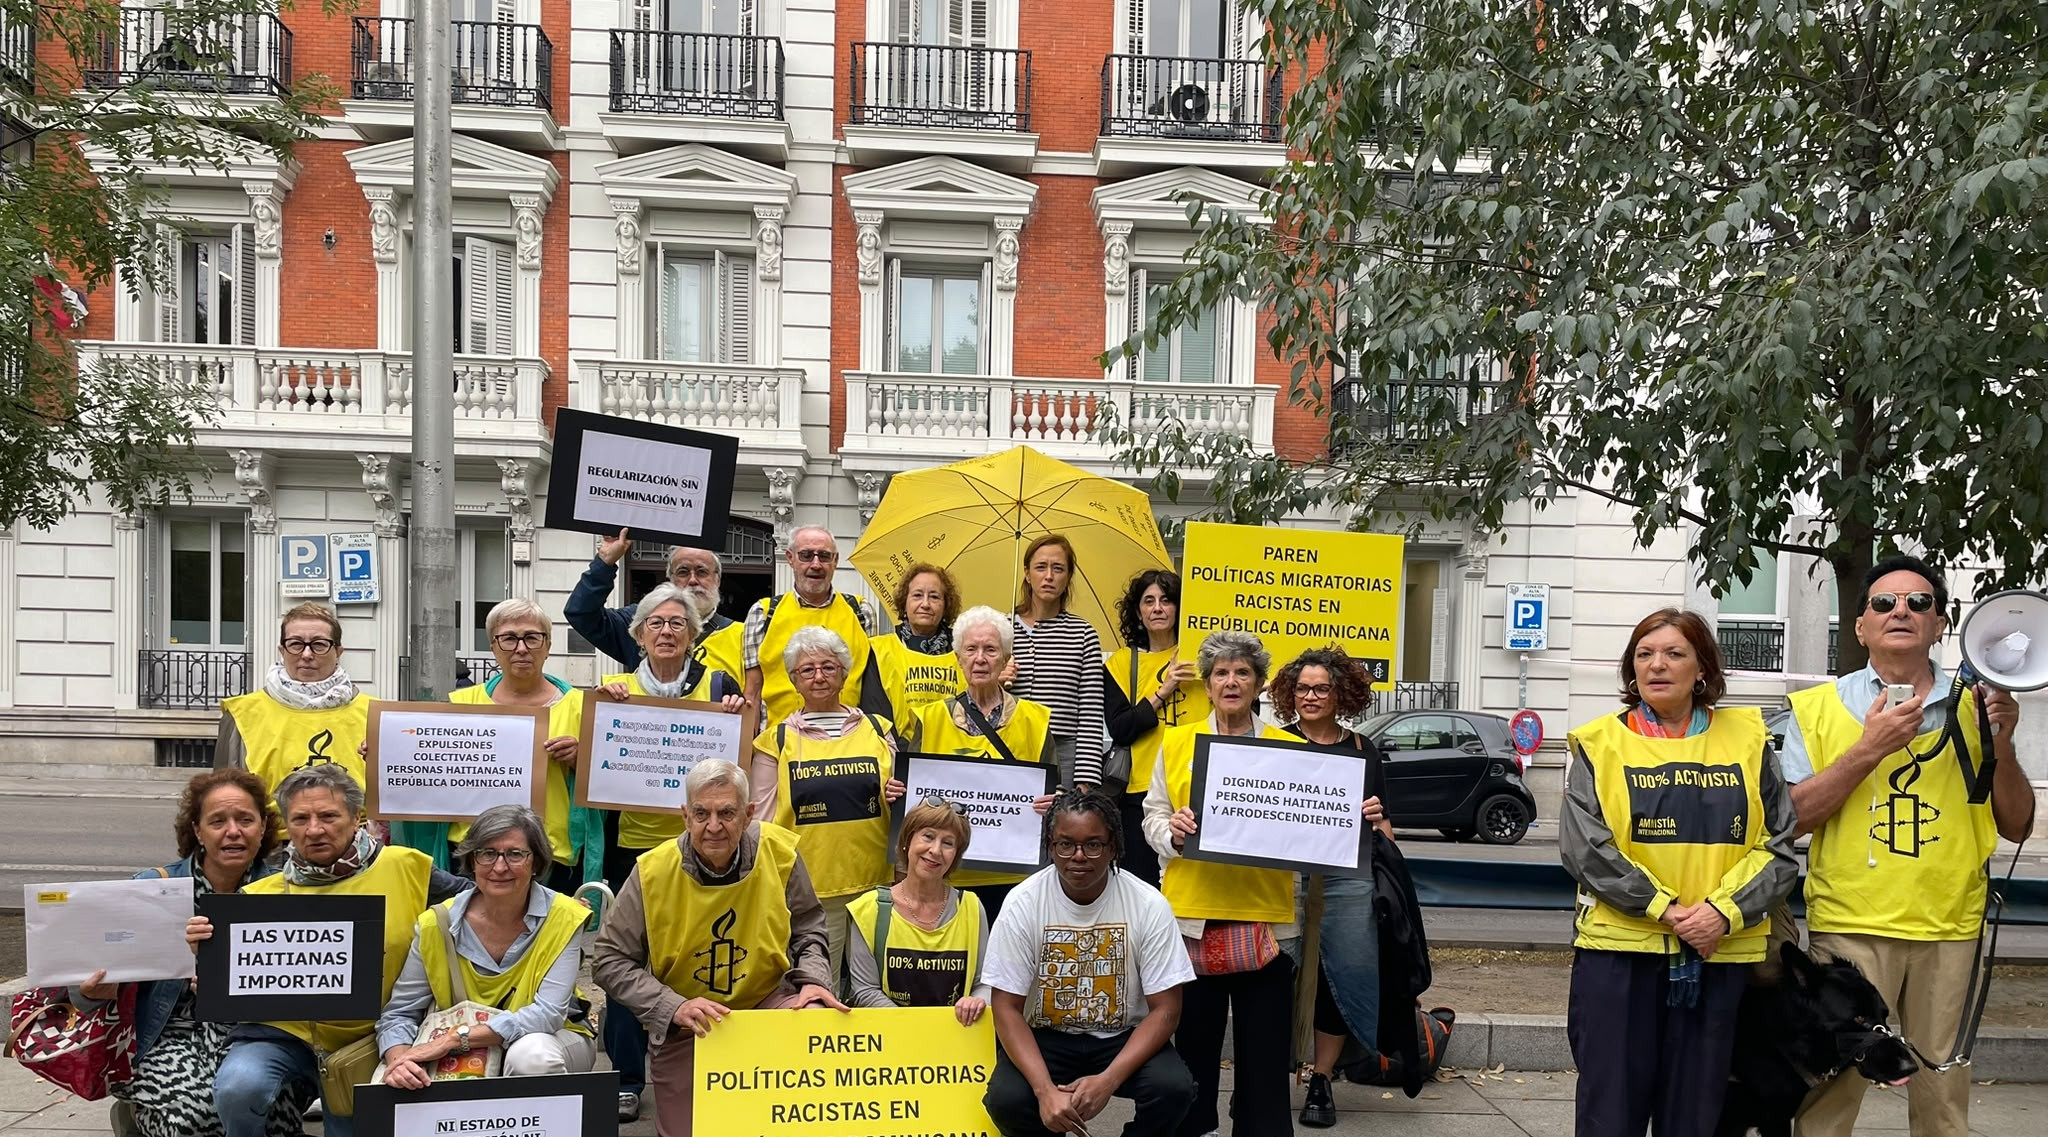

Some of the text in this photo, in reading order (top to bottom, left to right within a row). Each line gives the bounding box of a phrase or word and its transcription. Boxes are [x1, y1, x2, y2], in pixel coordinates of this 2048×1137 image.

[587, 466, 699, 490] REGULARIZACIÓN SIN
[589, 486, 693, 508] DISCRIMINACIÓN YA
[289, 540, 317, 575] P
[1264, 546, 1318, 563] PAREN
[303, 567, 325, 575] C.D.
[344, 554, 362, 578] P
[1191, 565, 1392, 592] POLÍTICAS MIGRATORIAS
[1235, 594, 1340, 613] RACISTAS EN
[1517, 603, 1535, 626] P
[1187, 615, 1390, 641] REPÚBLICA DOMINICANA
[905, 683, 957, 696] NTERNACIONAL
[416, 727, 496, 737] DETENGAN LAS
[613, 719, 722, 737] Respeten DDHH de
[419, 741, 492, 749] EXPULSIONES
[606, 733, 726, 752] Personas Haitianas y
[414, 753, 479, 761] COLECTIVAS
[620, 748, 694, 761] Dominicanas
[387, 765, 522, 775] PERSONAS HAITIANAS EN
[601, 760, 674, 774] Ascendencia
[792, 762, 876, 780] 100% ACTIVISTA
[388, 776, 521, 787] REPÚBLICA DOMINICANA
[646, 779, 680, 788] en RD
[1631, 769, 1739, 788] 100% ACTIVISTA
[916, 787, 1034, 803] DERECHOS HUMANOS
[1223, 777, 1346, 797] DIGNIDAD PARA LAS
[1216, 791, 1350, 812] PERSONAS HAITIANAS
[1001, 806, 1021, 815] LAS
[1211, 805, 1353, 828] Y AFRODESCENDIENTES
[970, 817, 1002, 826] ONAS
[1639, 816, 1676, 828] AMNISTÍA
[242, 929, 344, 943] LAS VIDAS
[237, 952, 347, 966] HAITIANAS
[889, 956, 914, 970] 00%
[238, 974, 344, 989] IMPORTAN
[808, 1034, 882, 1054] PAREN
[707, 1065, 986, 1091] POLÍTICAS MIGRATORIAS
[771, 1100, 920, 1123] RACISTAS EN
[438, 1116, 540, 1132] NI ESTADO DE
